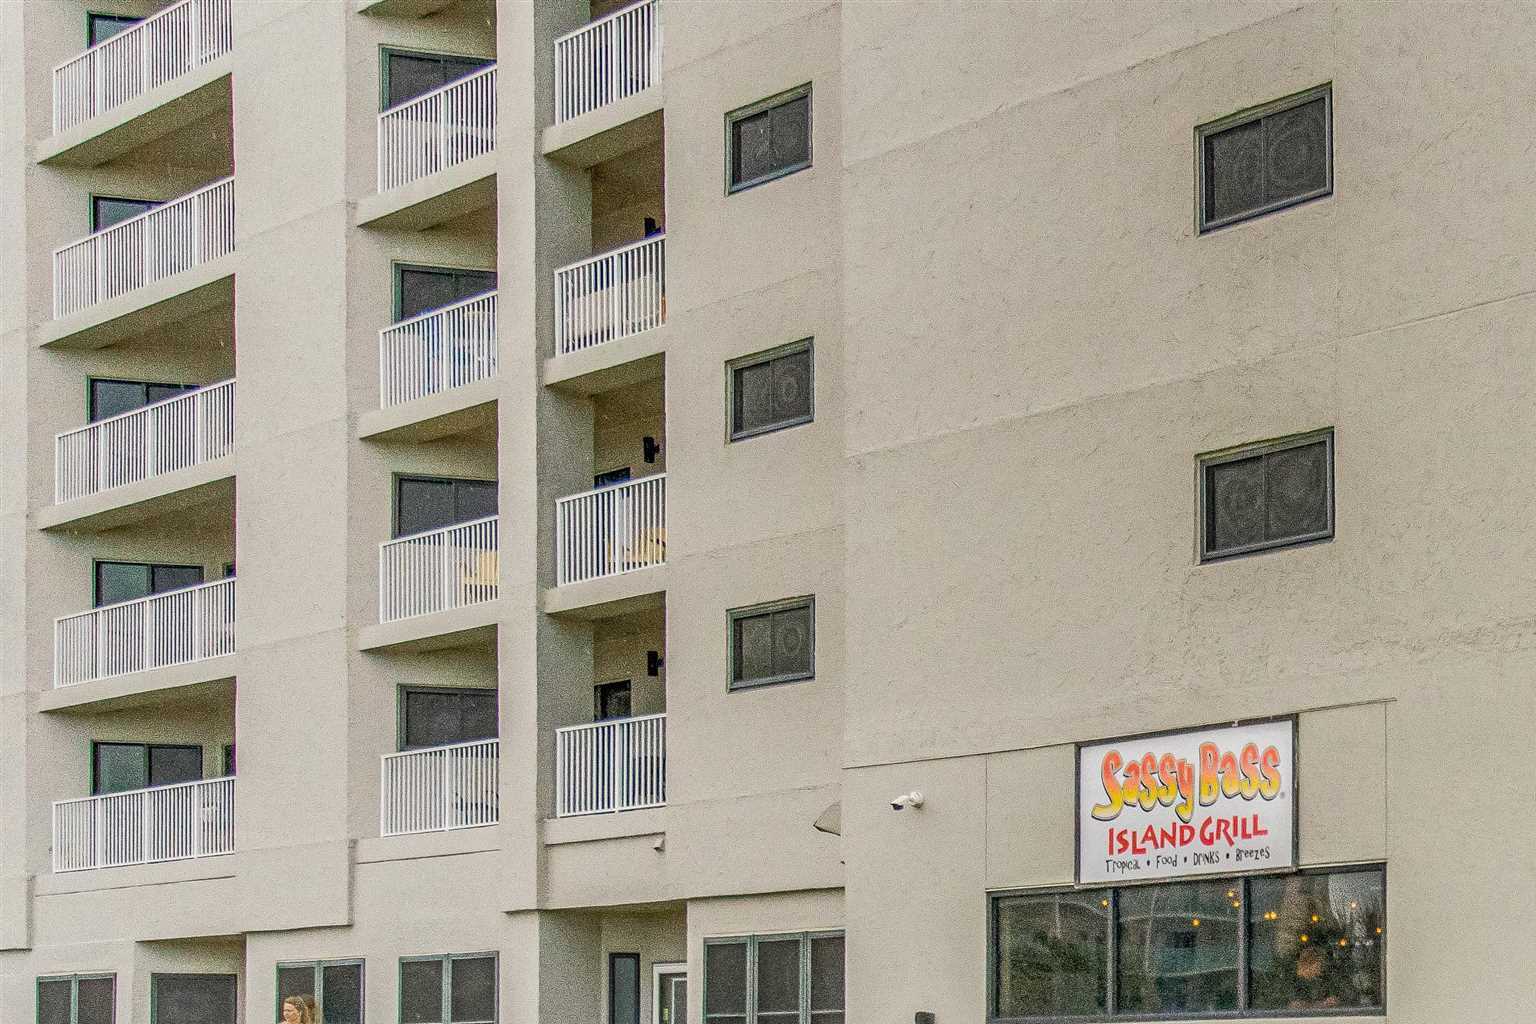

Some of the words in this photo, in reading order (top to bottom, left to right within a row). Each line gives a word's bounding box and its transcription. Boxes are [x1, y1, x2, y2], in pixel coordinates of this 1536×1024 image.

[1108, 822, 1196, 856] ISLAND
[1199, 814, 1268, 847] GRILL
[1156, 854, 1178, 868] Food
